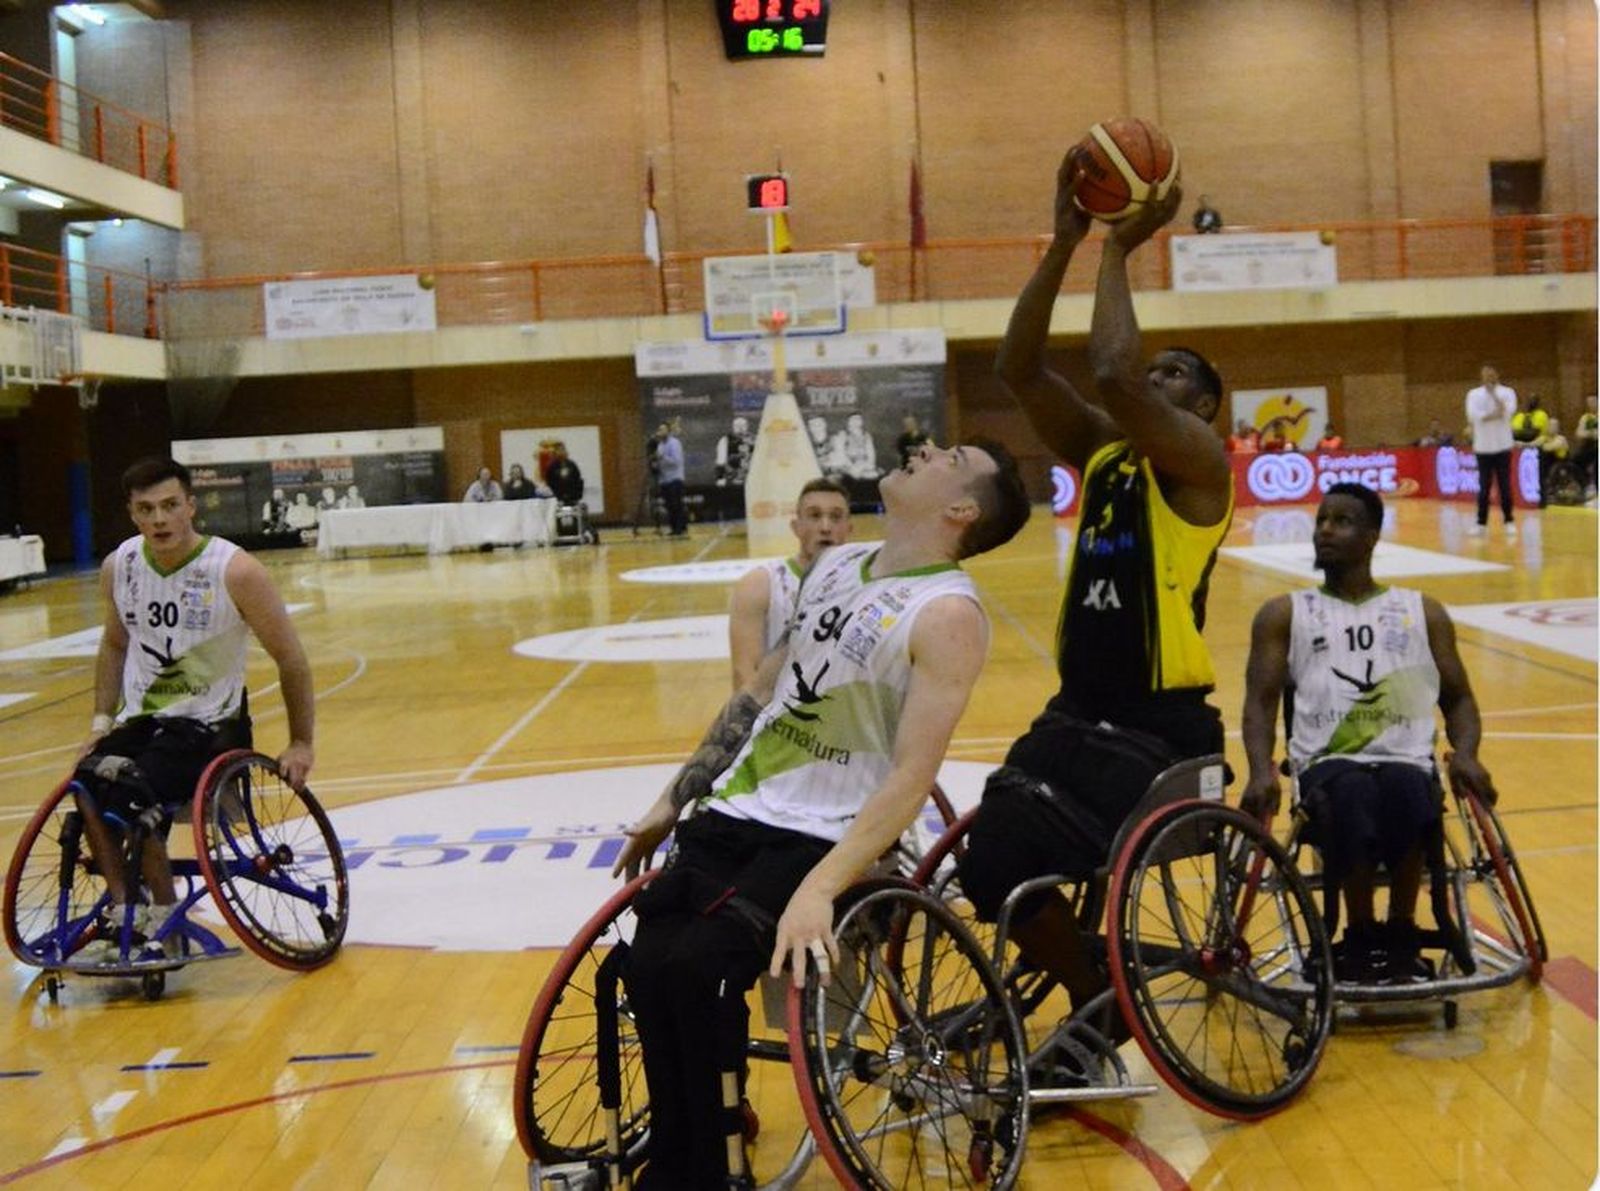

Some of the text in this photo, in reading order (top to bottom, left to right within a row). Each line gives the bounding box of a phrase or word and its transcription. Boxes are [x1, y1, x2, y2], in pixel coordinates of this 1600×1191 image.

[148, 601, 179, 628] 30
[812, 605, 853, 642] 94
[1345, 624, 1374, 651] 10
